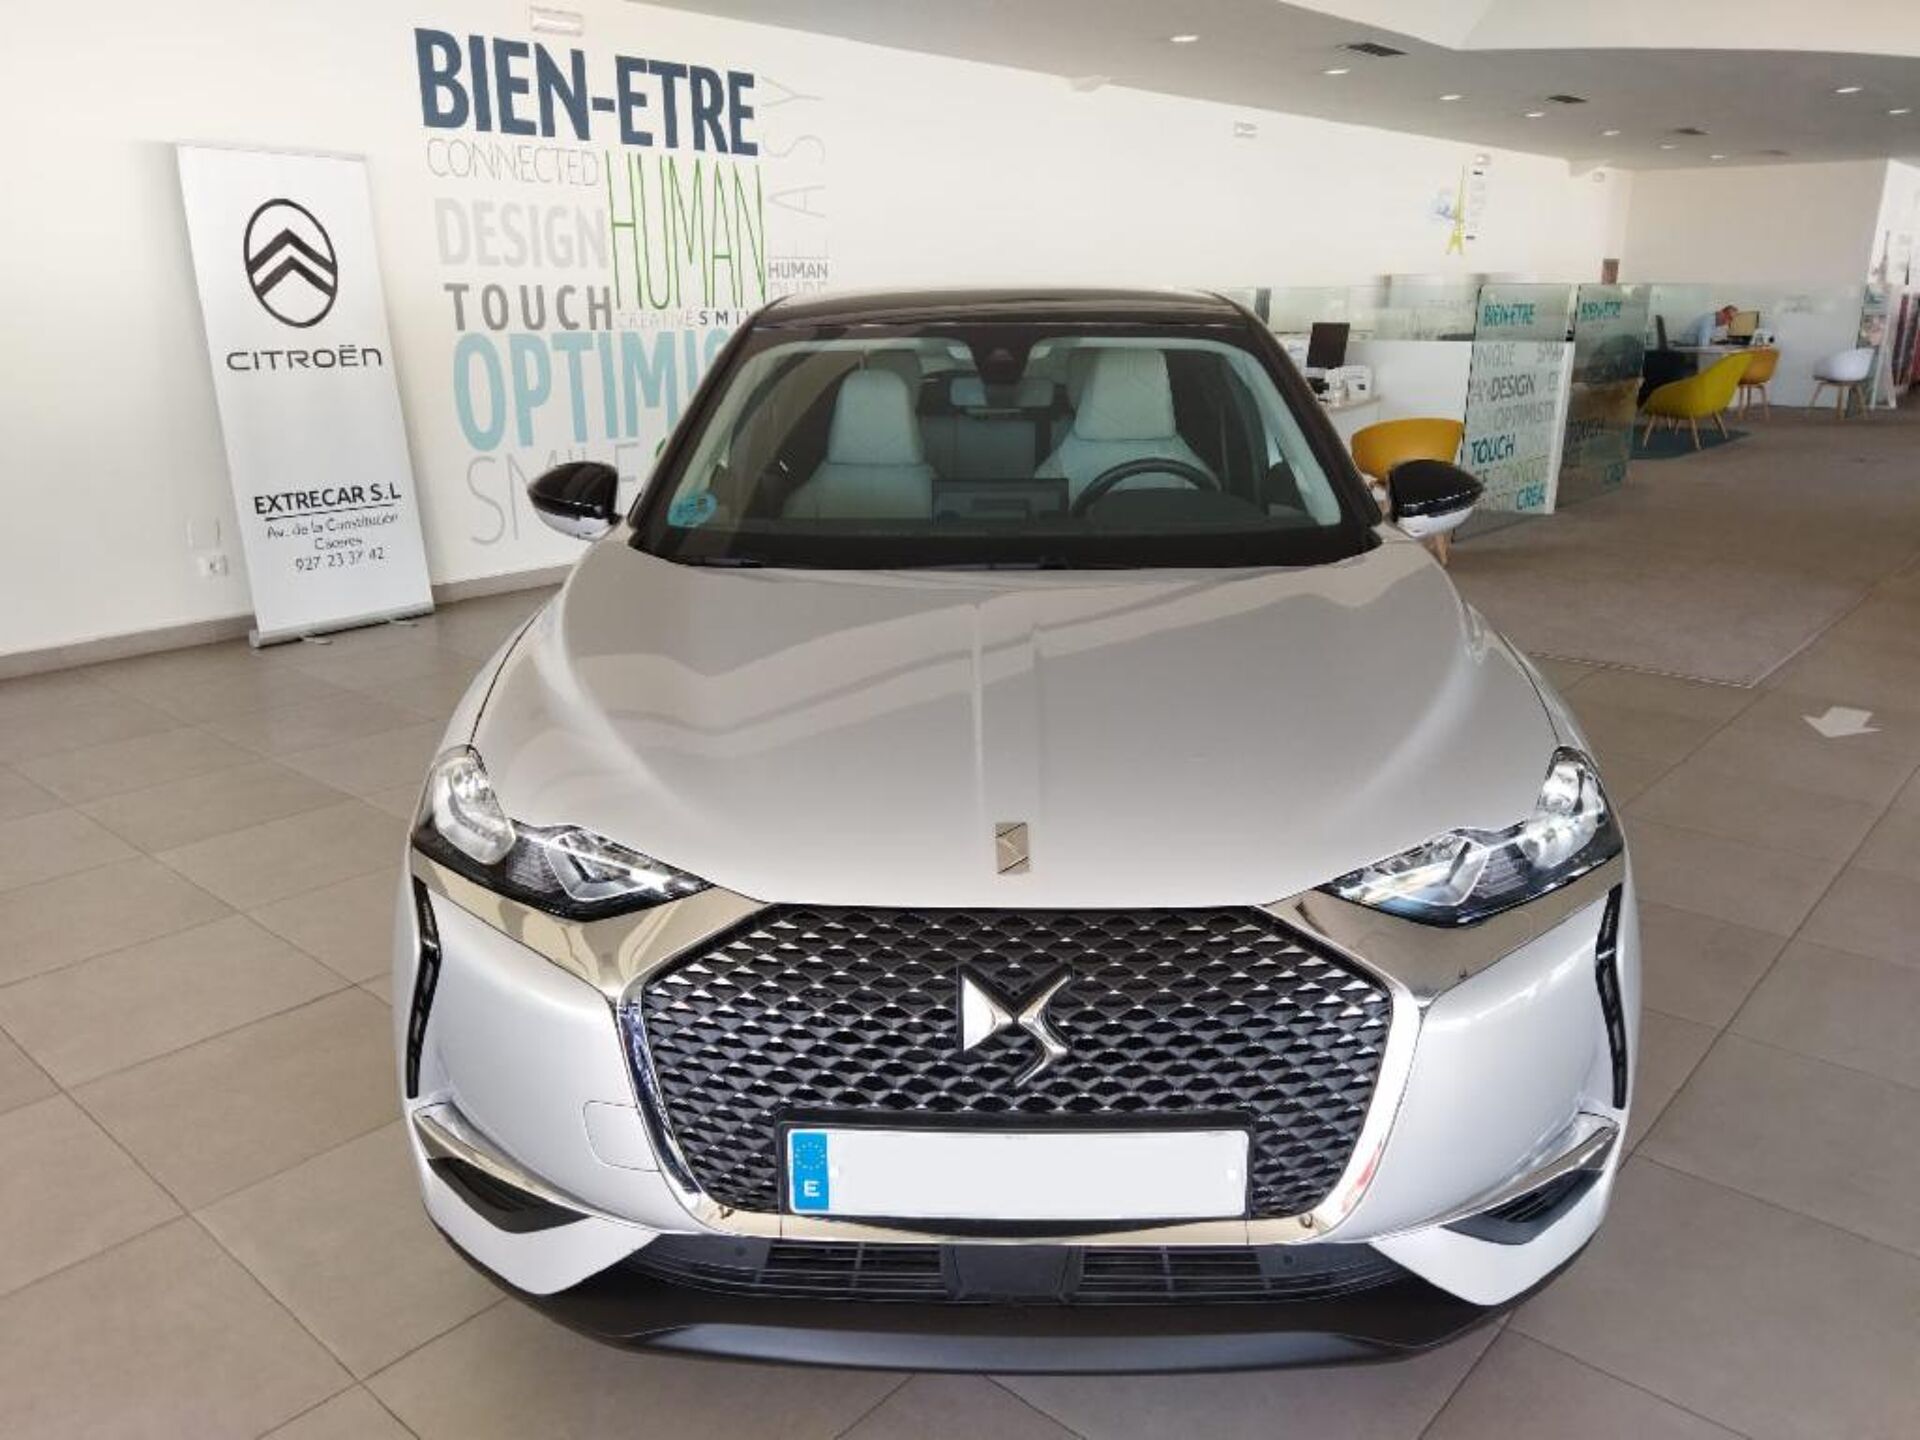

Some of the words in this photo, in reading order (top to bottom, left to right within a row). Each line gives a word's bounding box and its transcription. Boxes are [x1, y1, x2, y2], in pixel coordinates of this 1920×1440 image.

[414, 28, 759, 156] BIEN-ETRE
[427, 138, 598, 187] CONNECTED
[435, 198, 607, 270] DESIGN
[606, 151, 766, 310] HUMAN
[768, 262, 829, 280] HUMAN
[444, 283, 613, 332] TOUCH
[1488, 372, 1537, 402] DESIGN
[1470, 433, 1516, 467] TOUCH
[254, 486, 365, 515] EXTRECAR
[370, 482, 401, 502] S.L
[310, 519, 323, 534] la
[295, 556, 321, 571] 927
[328, 552, 344, 568] 23
[803, 1179, 820, 1198] E
